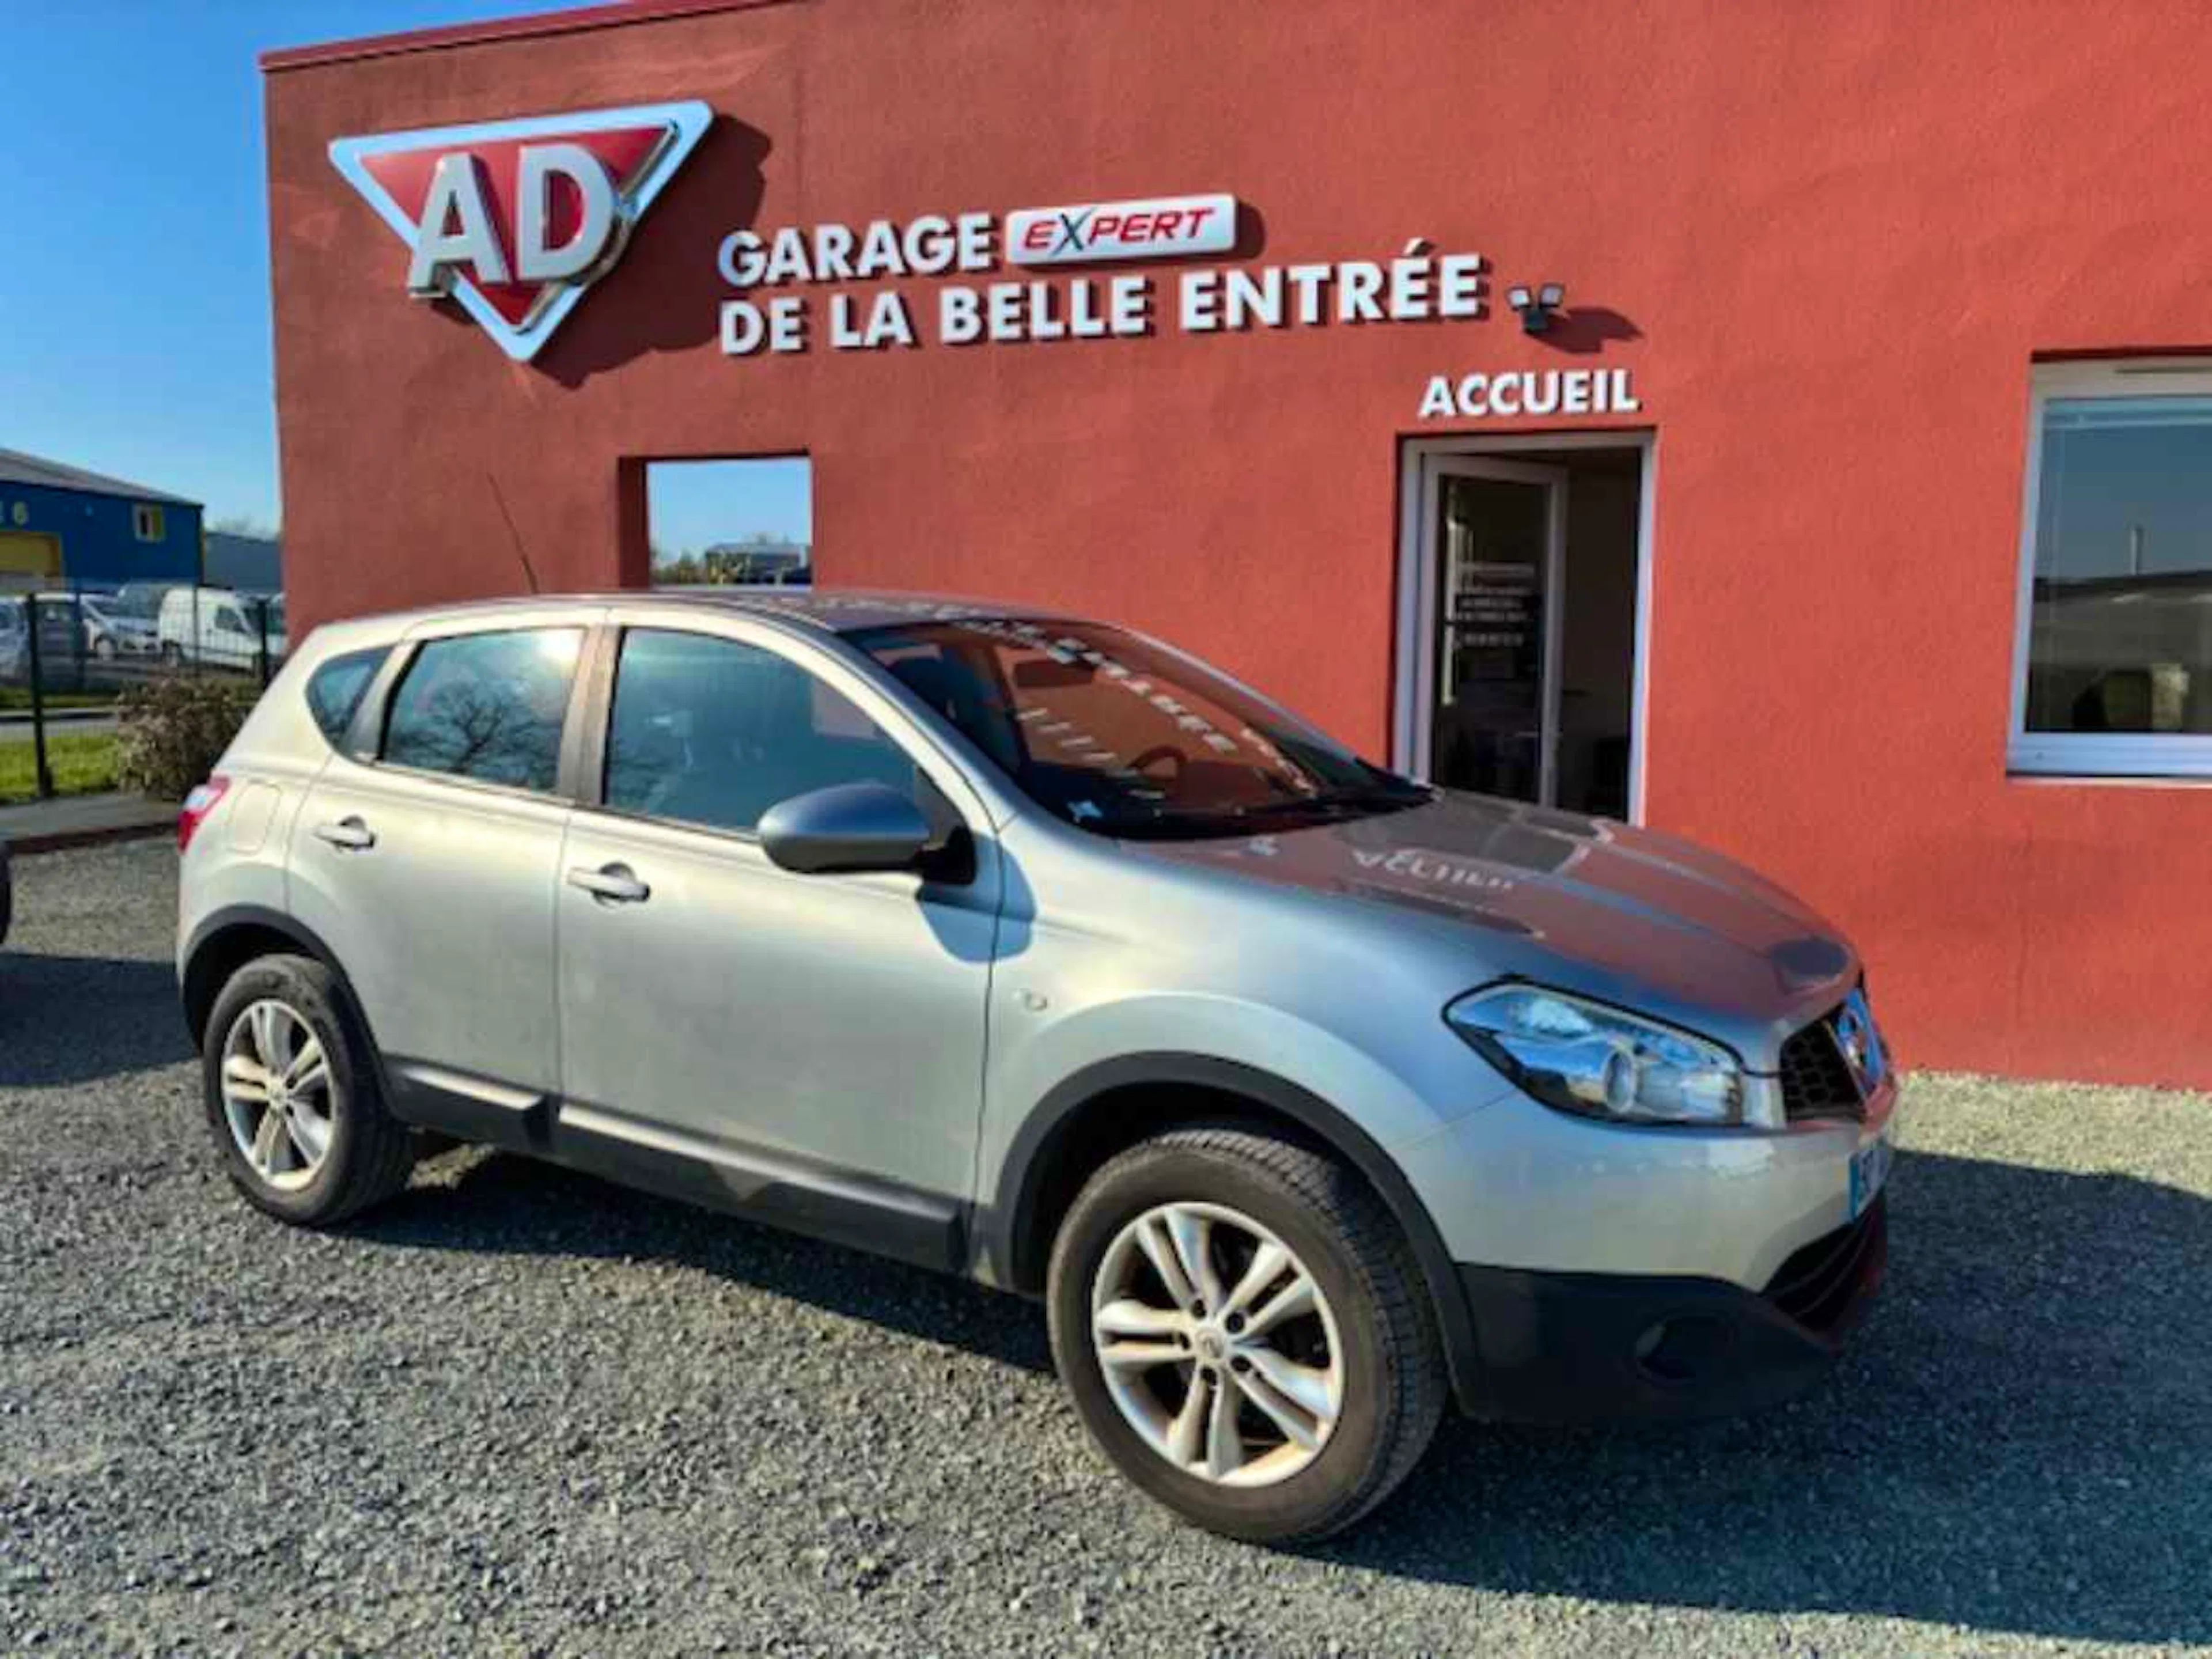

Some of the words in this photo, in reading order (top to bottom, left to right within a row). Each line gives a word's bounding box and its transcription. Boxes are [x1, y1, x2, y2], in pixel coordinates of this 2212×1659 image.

[408, 143, 615, 297] AD
[718, 214, 990, 286] GARAGE
[1025, 209, 1214, 256] EXPERT
[721, 297, 802, 354] DE
[830, 291, 912, 347] LA
[940, 276, 1146, 343] BELLE
[1180, 237, 1480, 329] ENTRÉE
[1418, 369, 1639, 416] ACCUEIL
